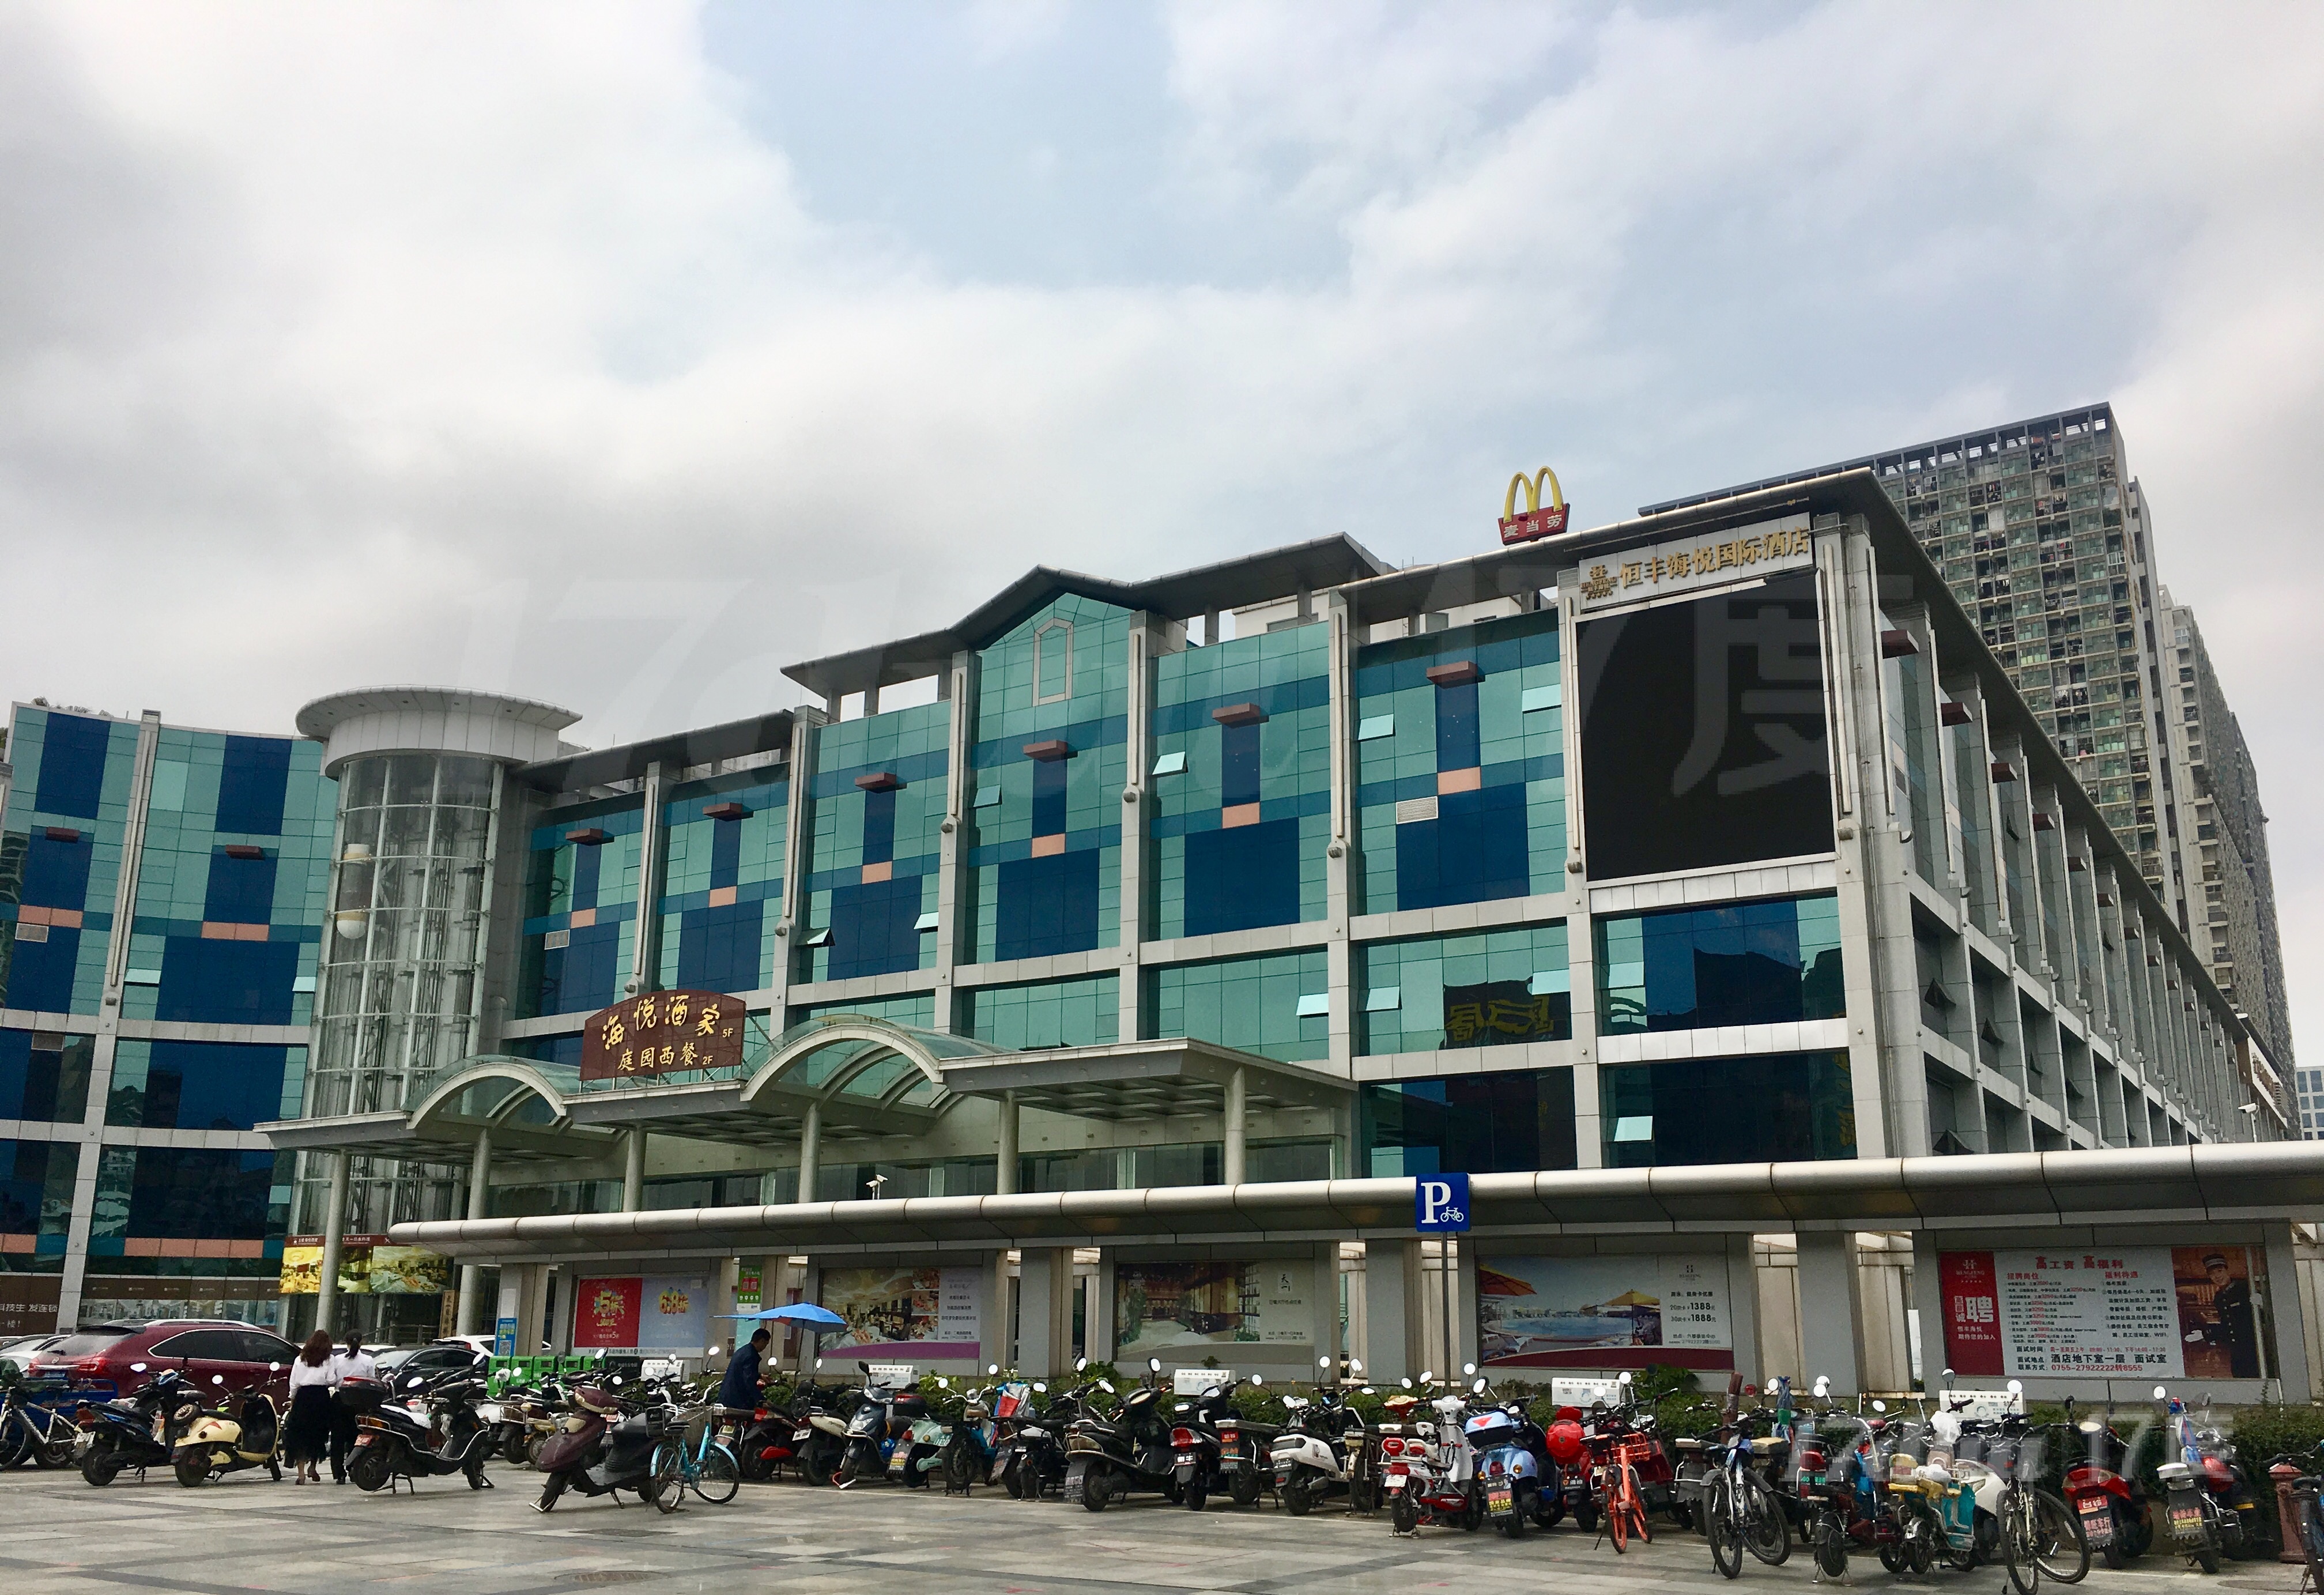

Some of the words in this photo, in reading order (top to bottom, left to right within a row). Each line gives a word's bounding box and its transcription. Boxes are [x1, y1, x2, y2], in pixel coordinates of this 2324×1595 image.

[1503, 515, 1564, 538] 麦当劳
[1619, 526, 1810, 589] 恒丰海悦国际酒店
[602, 995, 720, 1050] 海悦酒家
[722, 1028, 734, 1038] 5F
[617, 1042, 699, 1072] 庭园西餐
[703, 1055, 714, 1065] 2F
[1421, 1182, 1451, 1224] P
[2035, 1256, 2074, 1269] 高工资
[2084, 1255, 2123, 1269] 高福利
[2051, 1354, 2125, 1364] 酒店地下室一层
[2135, 1354, 2167, 1364] 面试室
